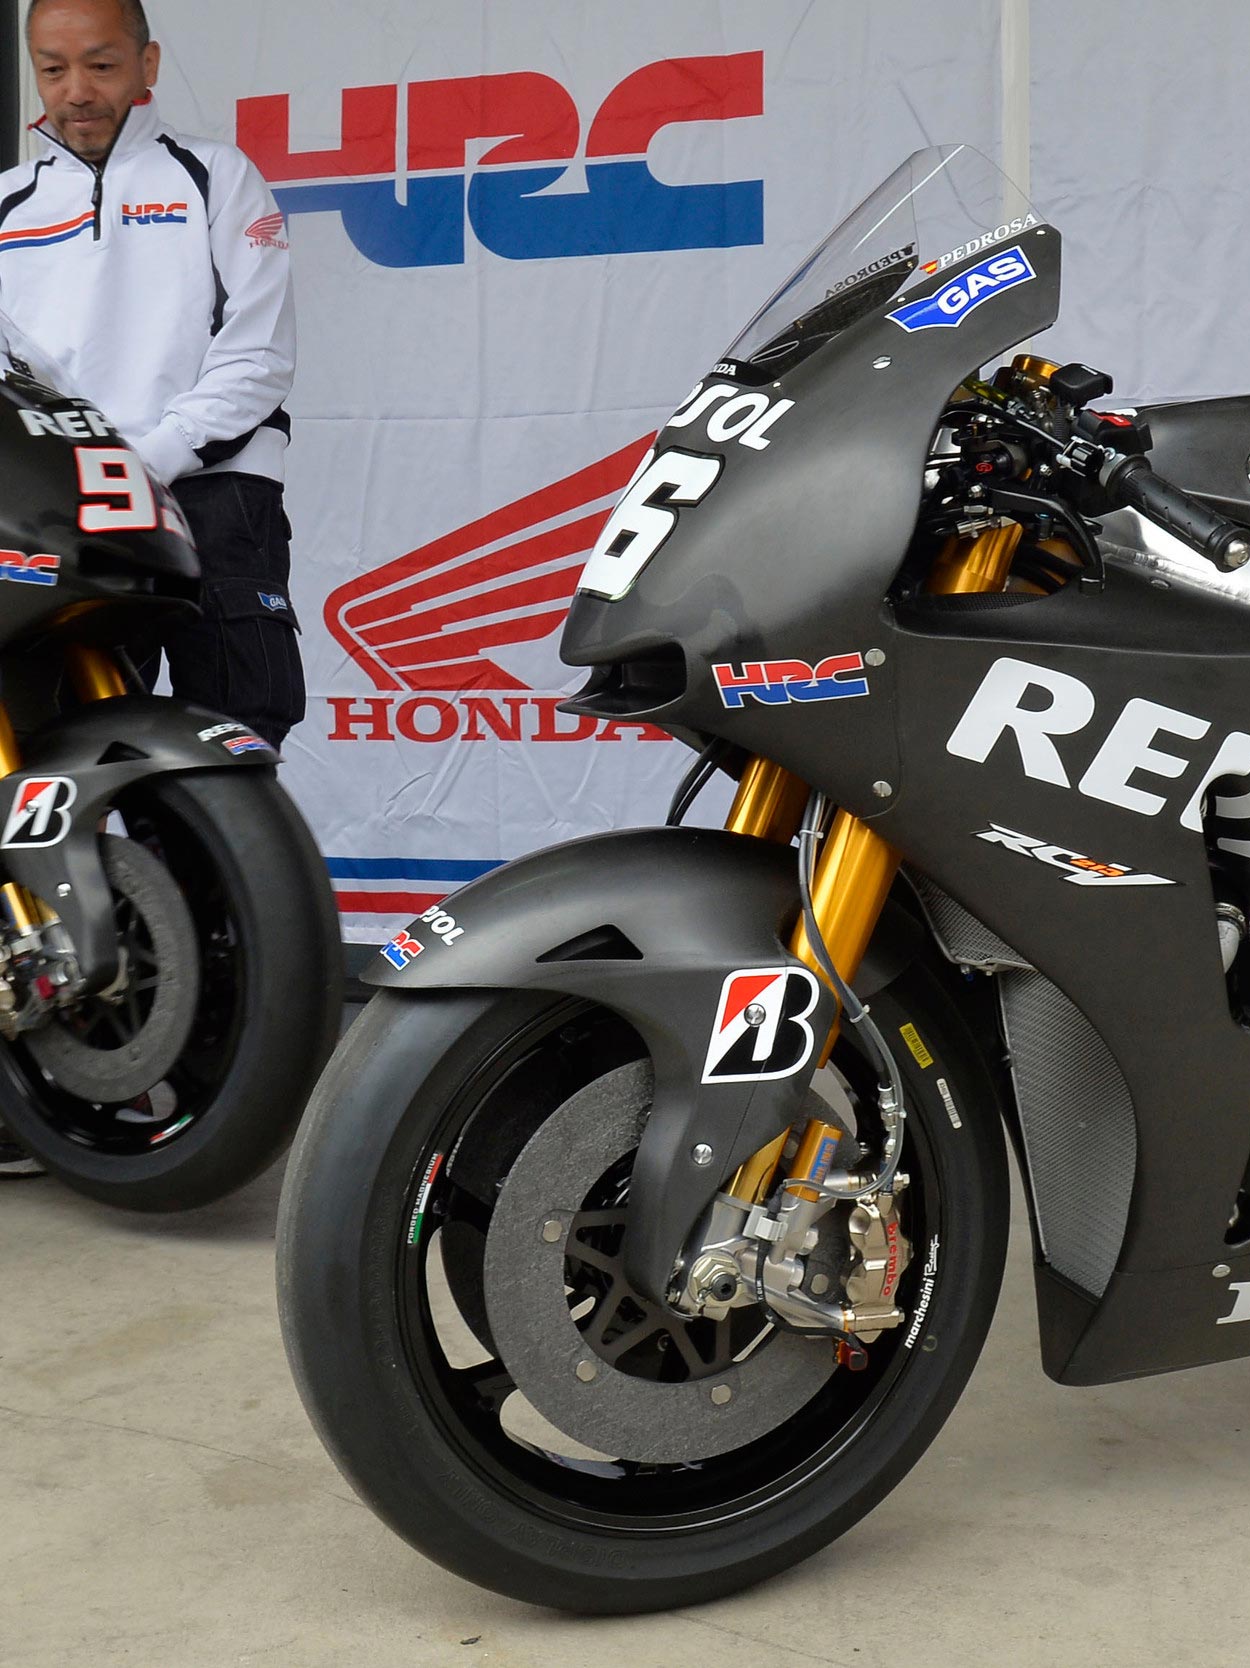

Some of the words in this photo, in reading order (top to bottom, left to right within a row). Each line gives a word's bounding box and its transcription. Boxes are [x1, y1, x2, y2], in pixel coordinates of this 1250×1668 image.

[236, 50, 763, 269] HRC
[122, 203, 187, 226] HRC
[938, 213, 1038, 269] PEDROSA
[936, 255, 1027, 315] GAS
[711, 651, 870, 710] HRC
[326, 697, 674, 742] HONDA
[882, 1221, 899, 1297] brembo
[904, 1277, 935, 1349] marchesini
